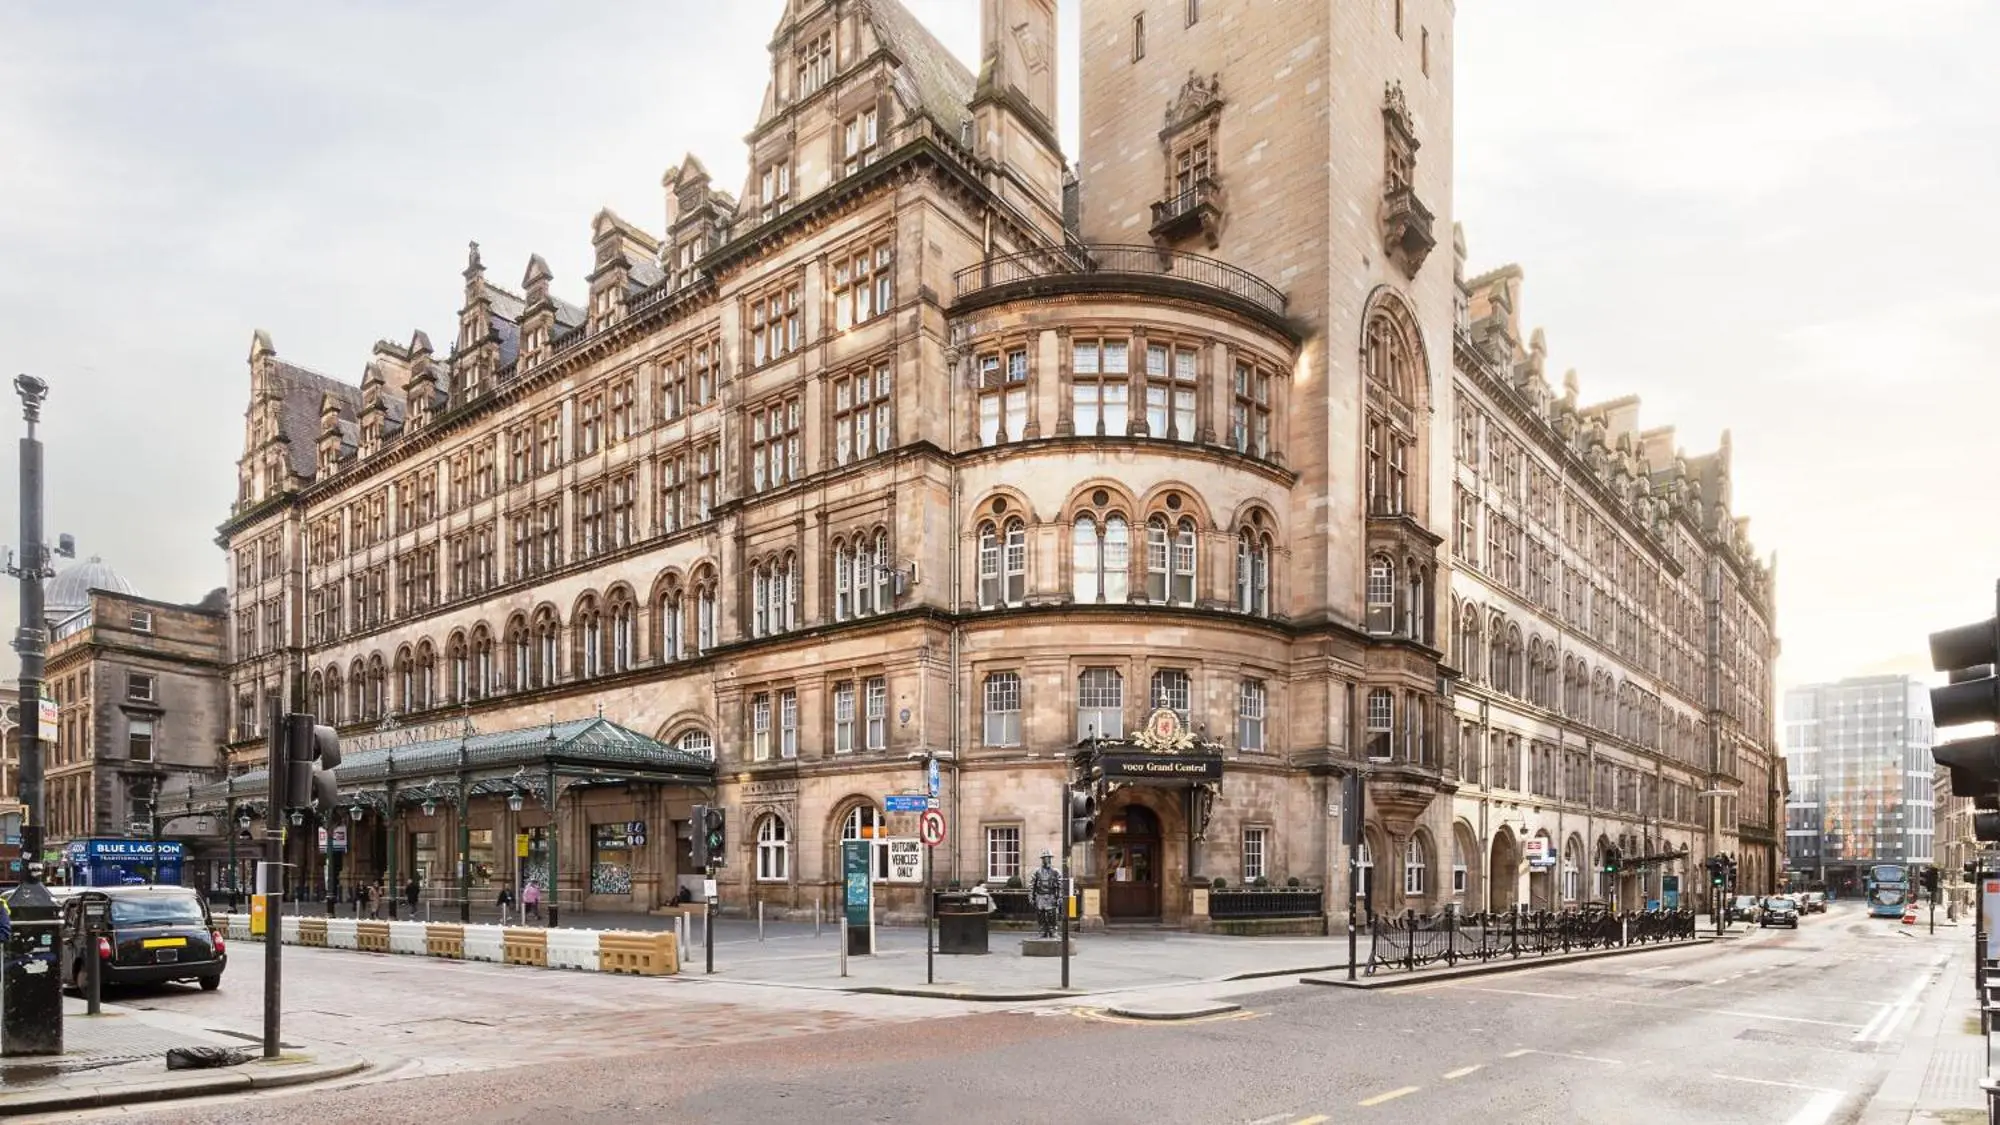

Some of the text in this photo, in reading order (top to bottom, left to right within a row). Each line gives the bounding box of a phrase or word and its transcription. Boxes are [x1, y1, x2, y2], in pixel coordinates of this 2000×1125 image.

[1122, 762, 1206, 772] voco Grand Central
[97, 844, 125, 852] BLUE
[892, 842, 919, 852] OUTGOING
[892, 854, 918, 865] VEHICLES
[897, 866, 913, 877] ONLY
